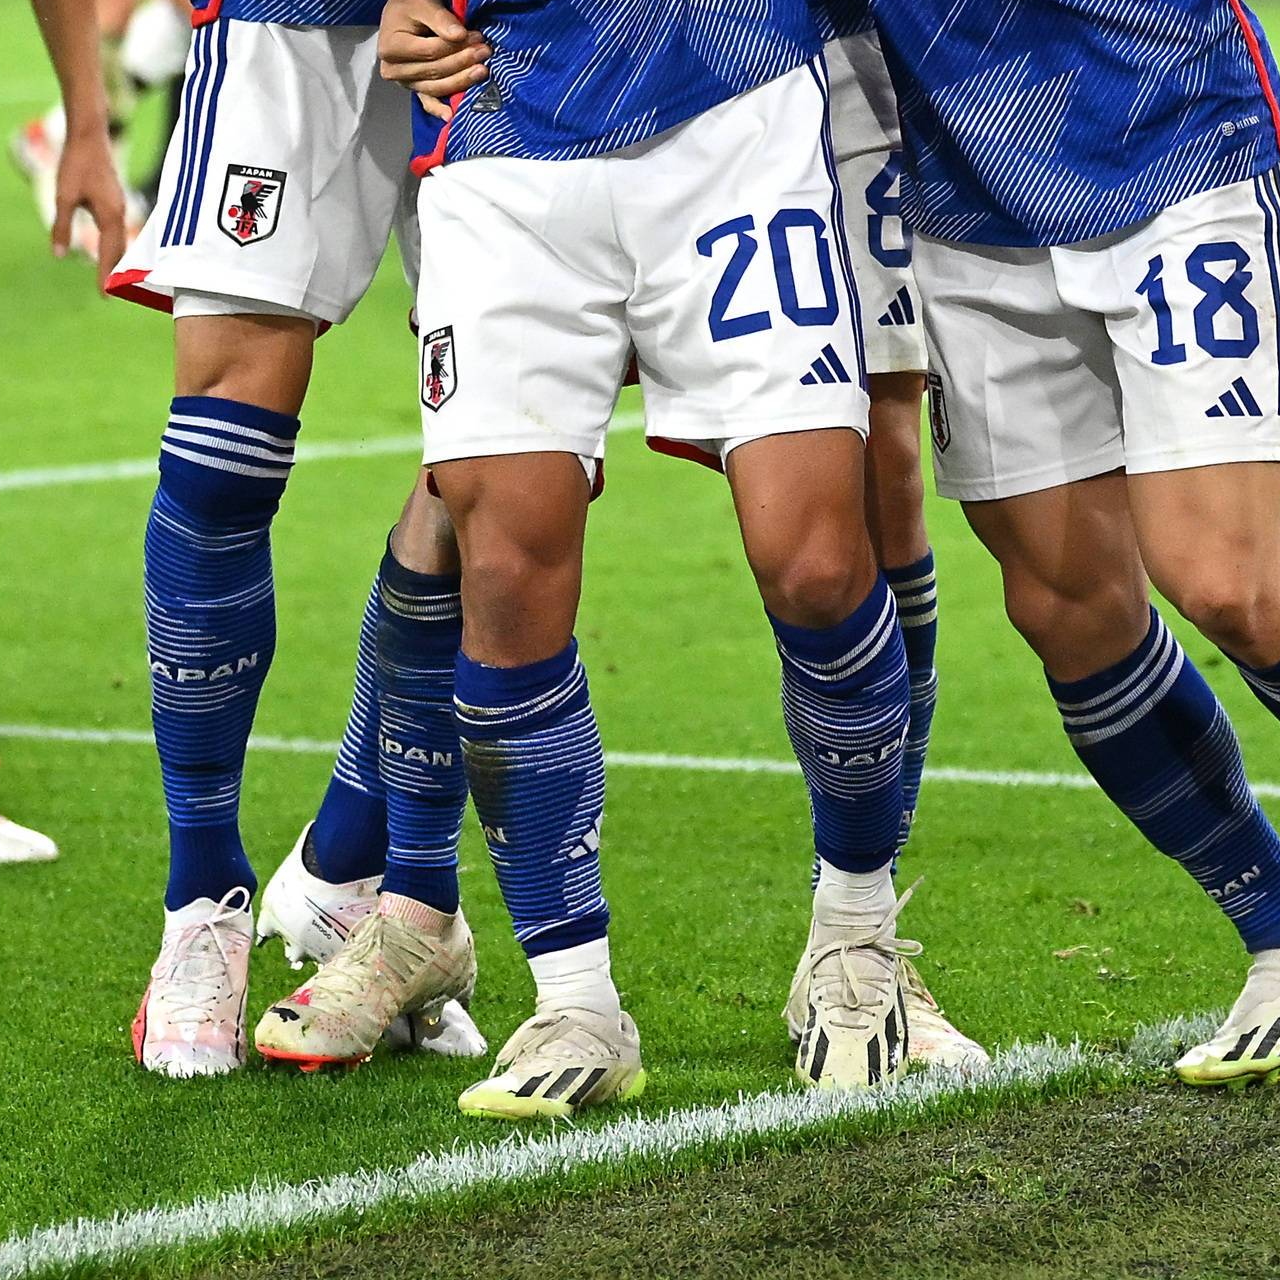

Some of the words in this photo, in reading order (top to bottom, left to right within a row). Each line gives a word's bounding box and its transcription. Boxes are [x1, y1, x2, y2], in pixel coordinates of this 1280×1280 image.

[240, 167, 273, 178] JAPAN
[231, 220, 258, 235] JFA
[696, 208, 839, 342] 20
[1135, 241, 1260, 365] 18
[148, 652, 258, 682] APAN
[380, 733, 452, 766] PAN
